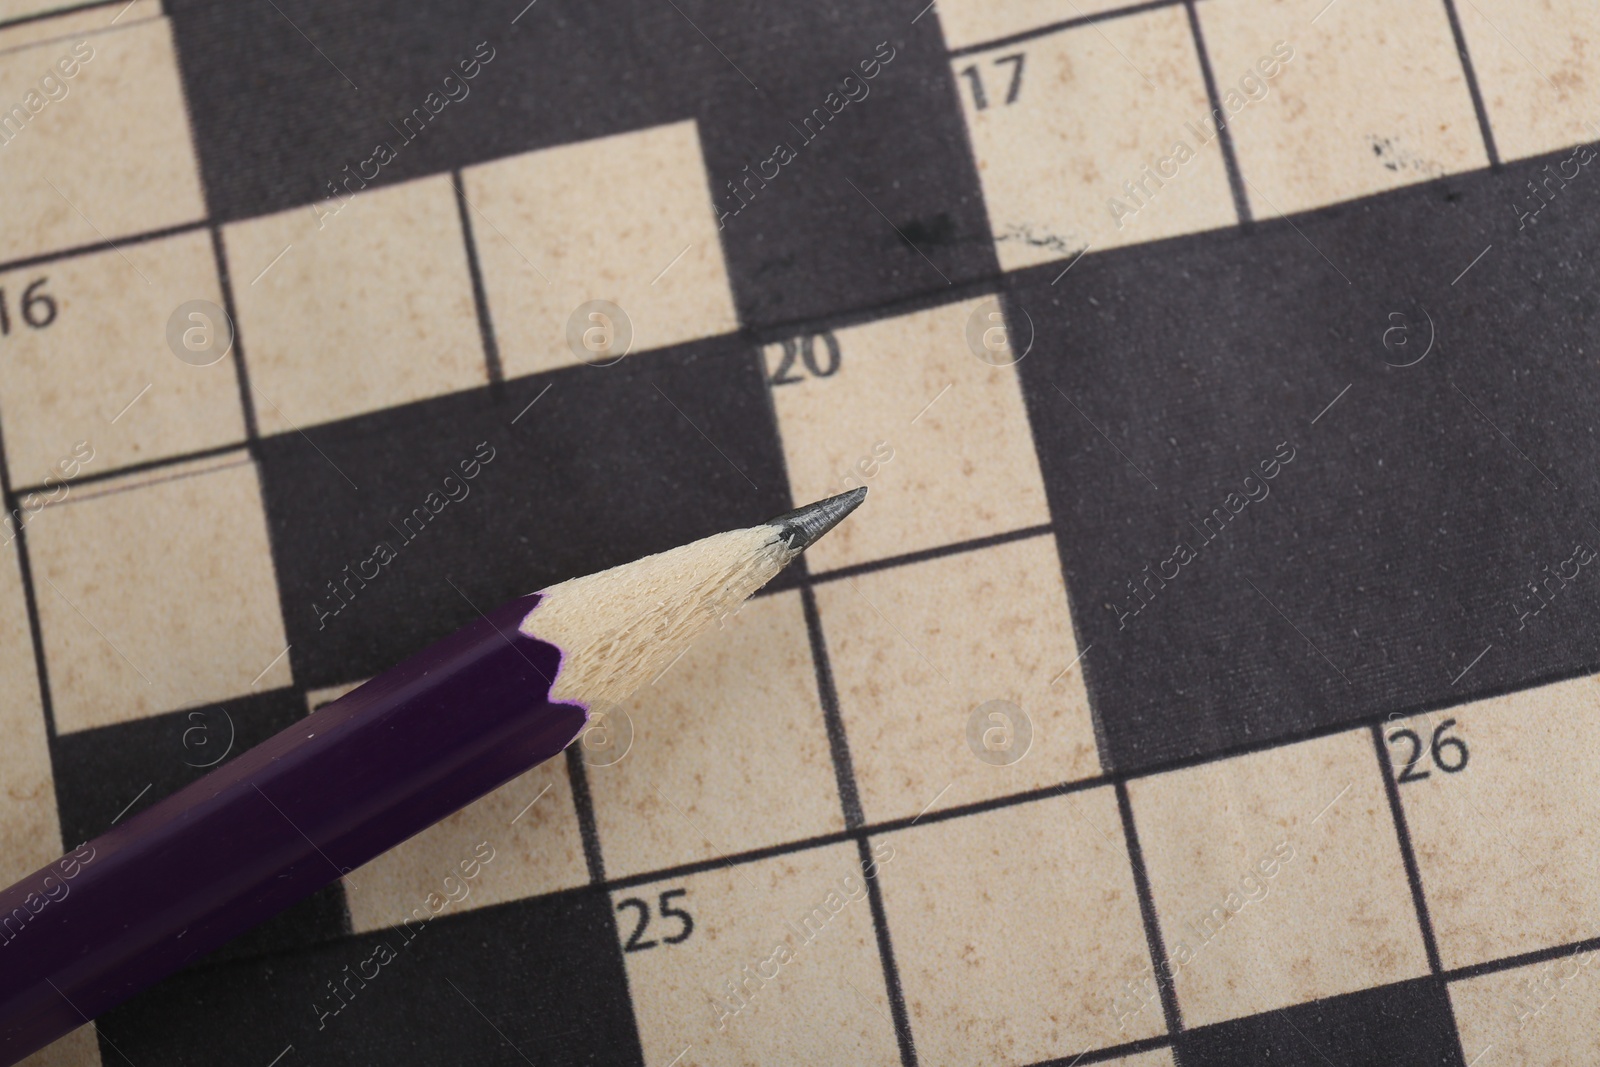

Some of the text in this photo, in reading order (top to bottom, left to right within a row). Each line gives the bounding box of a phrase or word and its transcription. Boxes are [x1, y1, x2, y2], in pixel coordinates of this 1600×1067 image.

[960, 53, 1025, 111] 17
[765, 331, 841, 386] 20
[1388, 718, 1469, 784] 26
[616, 888, 694, 953] 25
